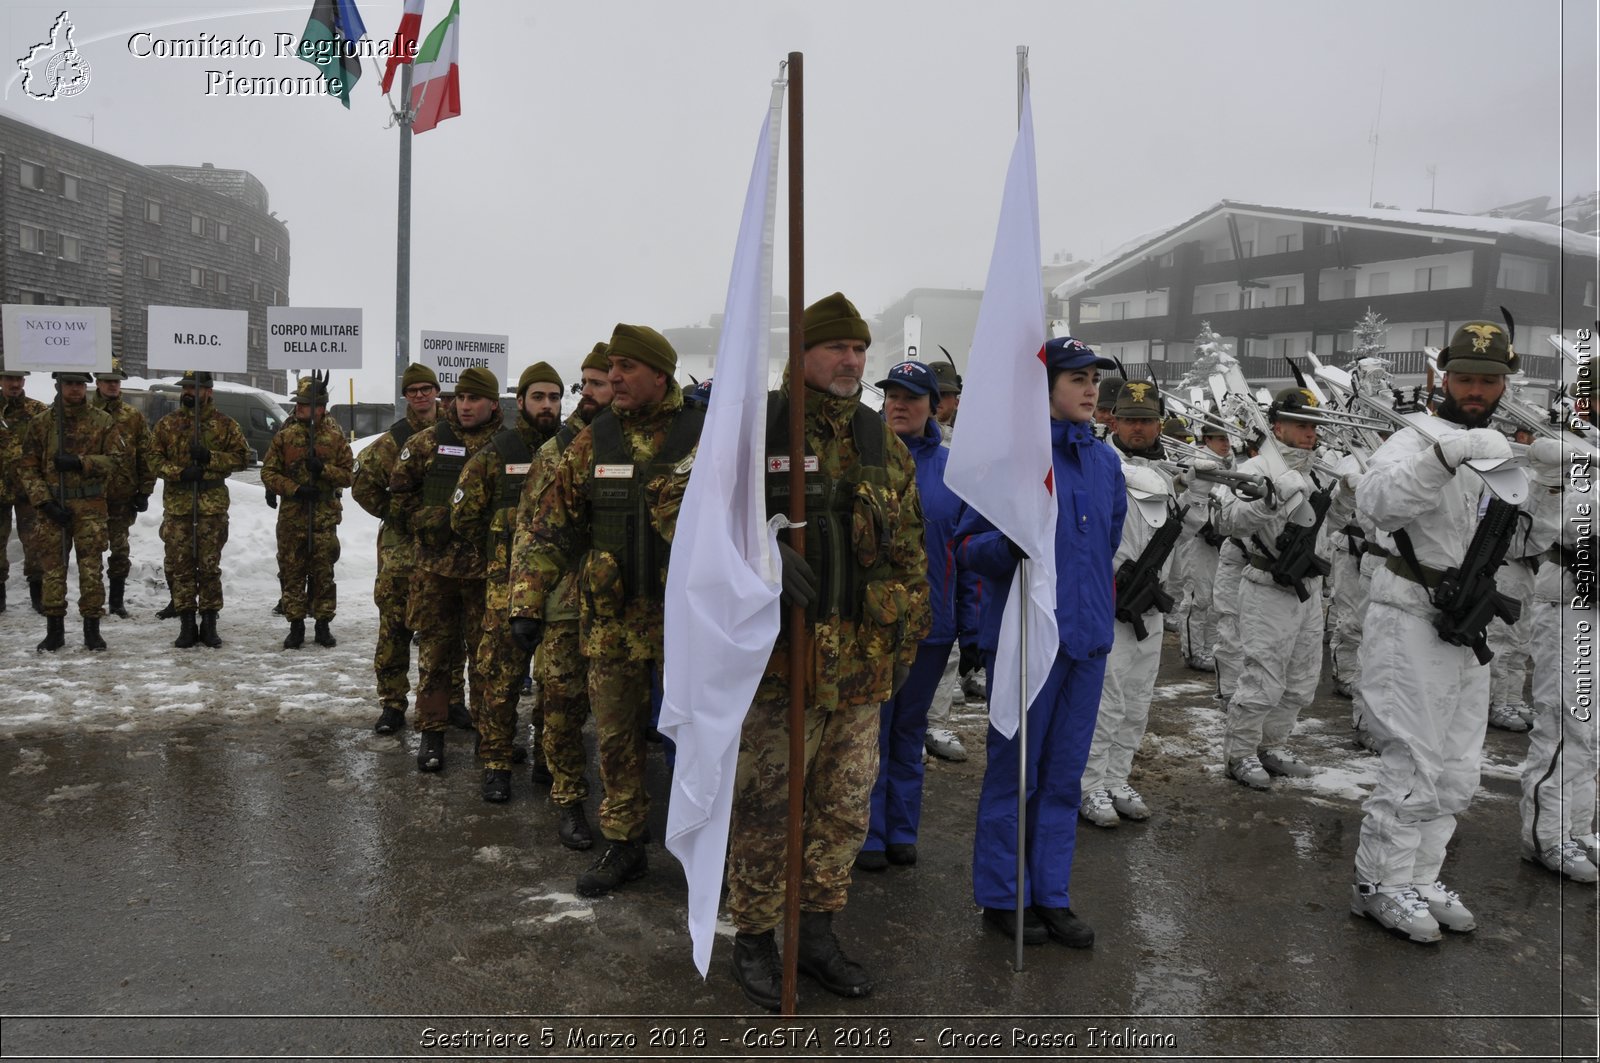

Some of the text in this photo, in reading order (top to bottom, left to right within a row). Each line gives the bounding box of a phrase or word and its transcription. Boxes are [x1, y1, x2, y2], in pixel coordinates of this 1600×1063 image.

[26, 320, 88, 331] NATO MW
[271, 324, 359, 336] CORPO MILITARE
[45, 336, 70, 346] COE
[174, 333, 222, 346] N.R.D.C.
[283, 341, 347, 353] DELLA C.R.I.
[424, 338, 505, 354] CORPO INFERMIERE
[437, 356, 489, 368] VOLONTARIE
[439, 372, 459, 383] DELL
